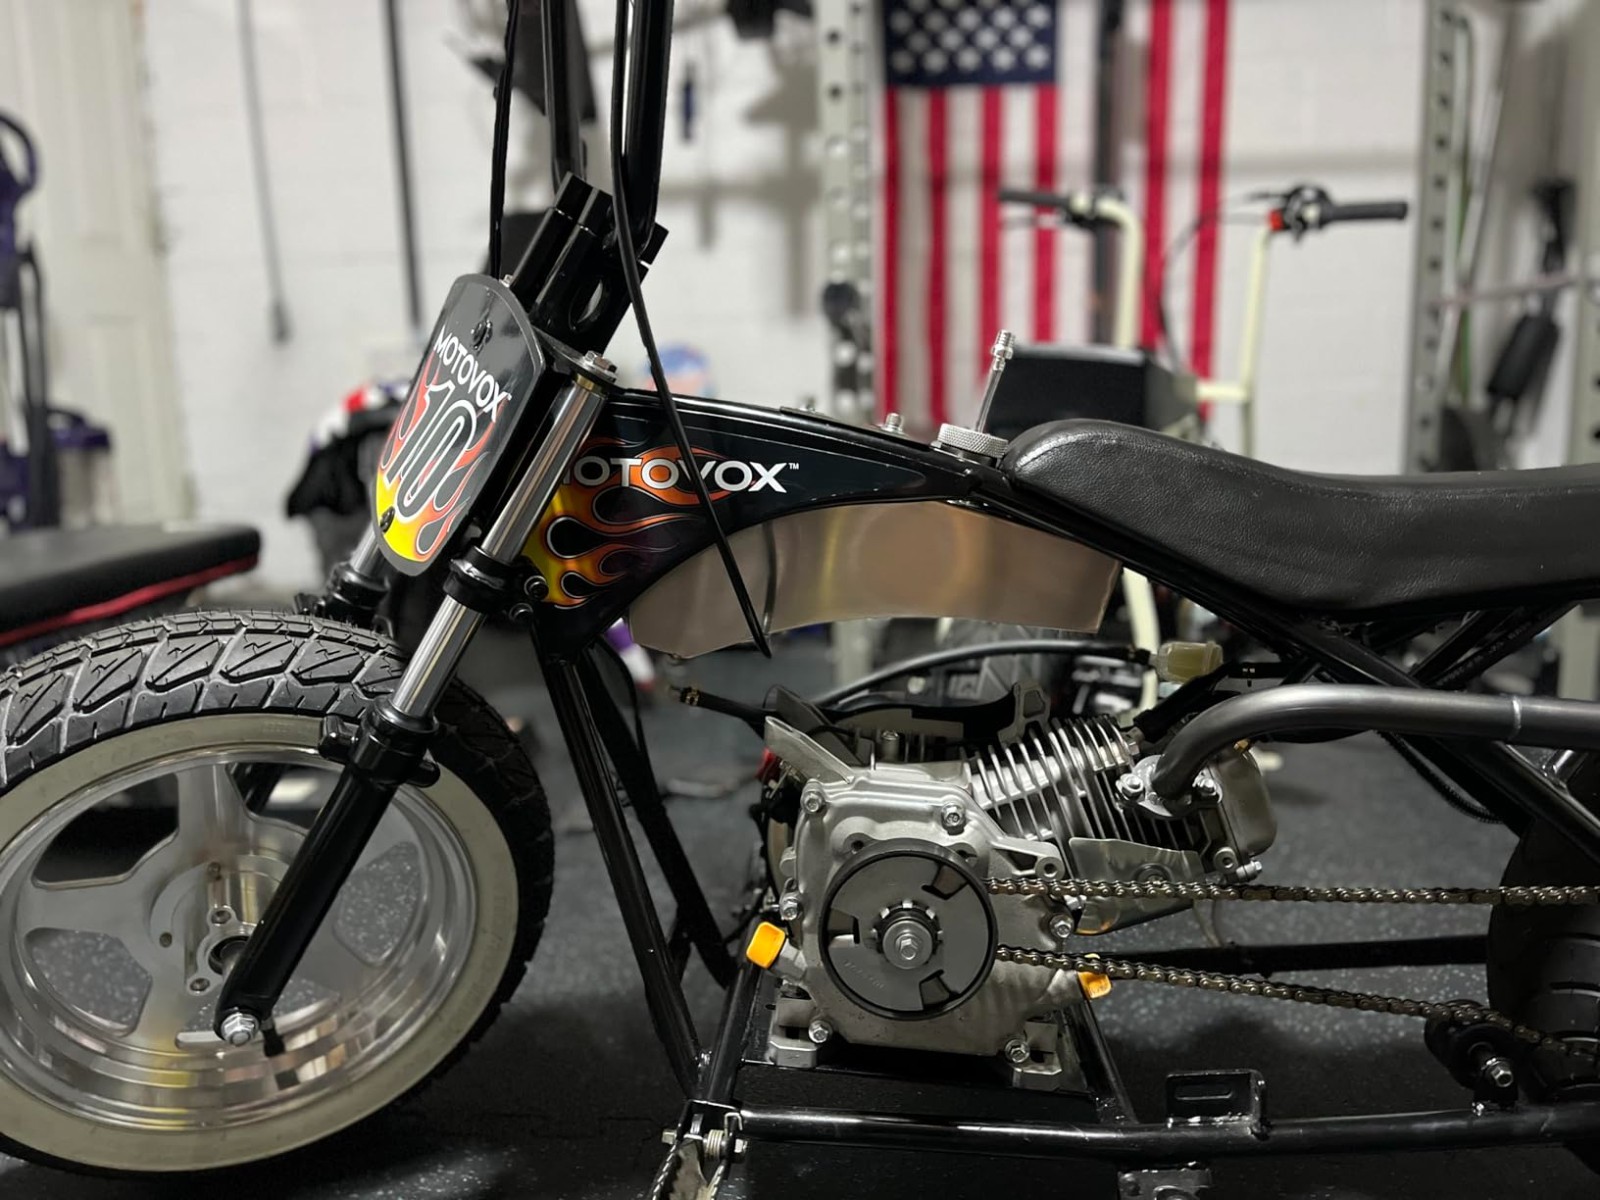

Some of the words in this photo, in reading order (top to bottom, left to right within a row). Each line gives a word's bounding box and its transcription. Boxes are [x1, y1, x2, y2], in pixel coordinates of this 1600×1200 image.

[433, 325, 509, 423] MOTOVOX
[383, 380, 477, 522] 10
[563, 456, 787, 493] OTOVOX
